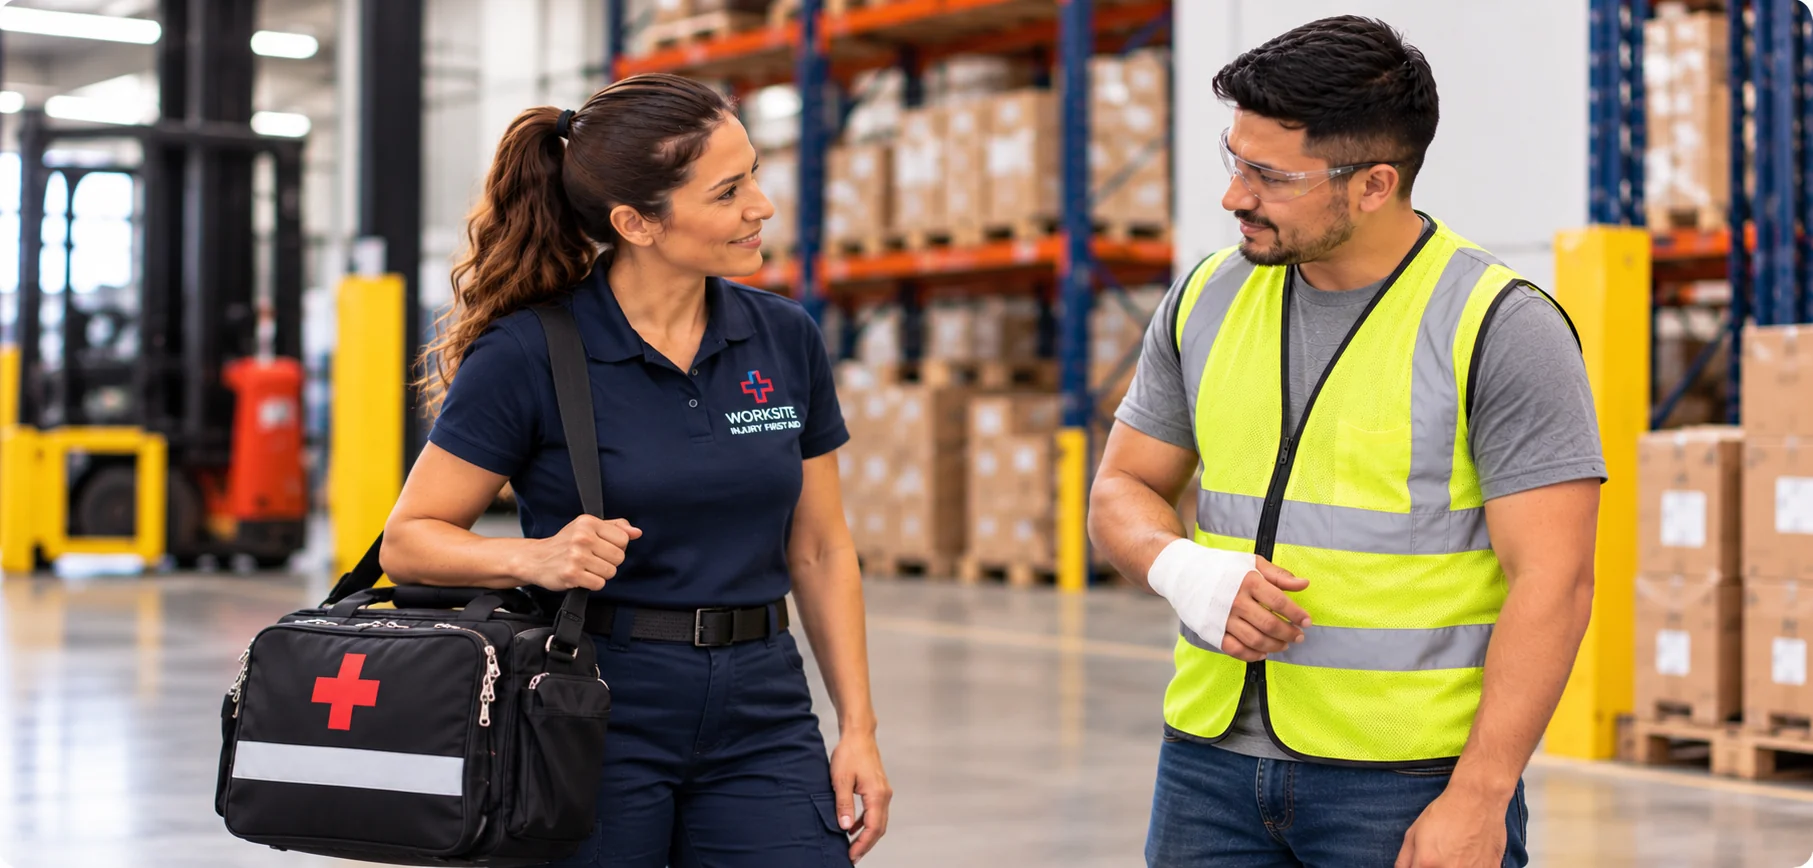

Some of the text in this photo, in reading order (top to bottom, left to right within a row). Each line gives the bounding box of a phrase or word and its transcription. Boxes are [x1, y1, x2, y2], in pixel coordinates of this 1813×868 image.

[725, 406, 797, 424] WORKSITE
[730, 420, 801, 435] INJURY FIRST AID
